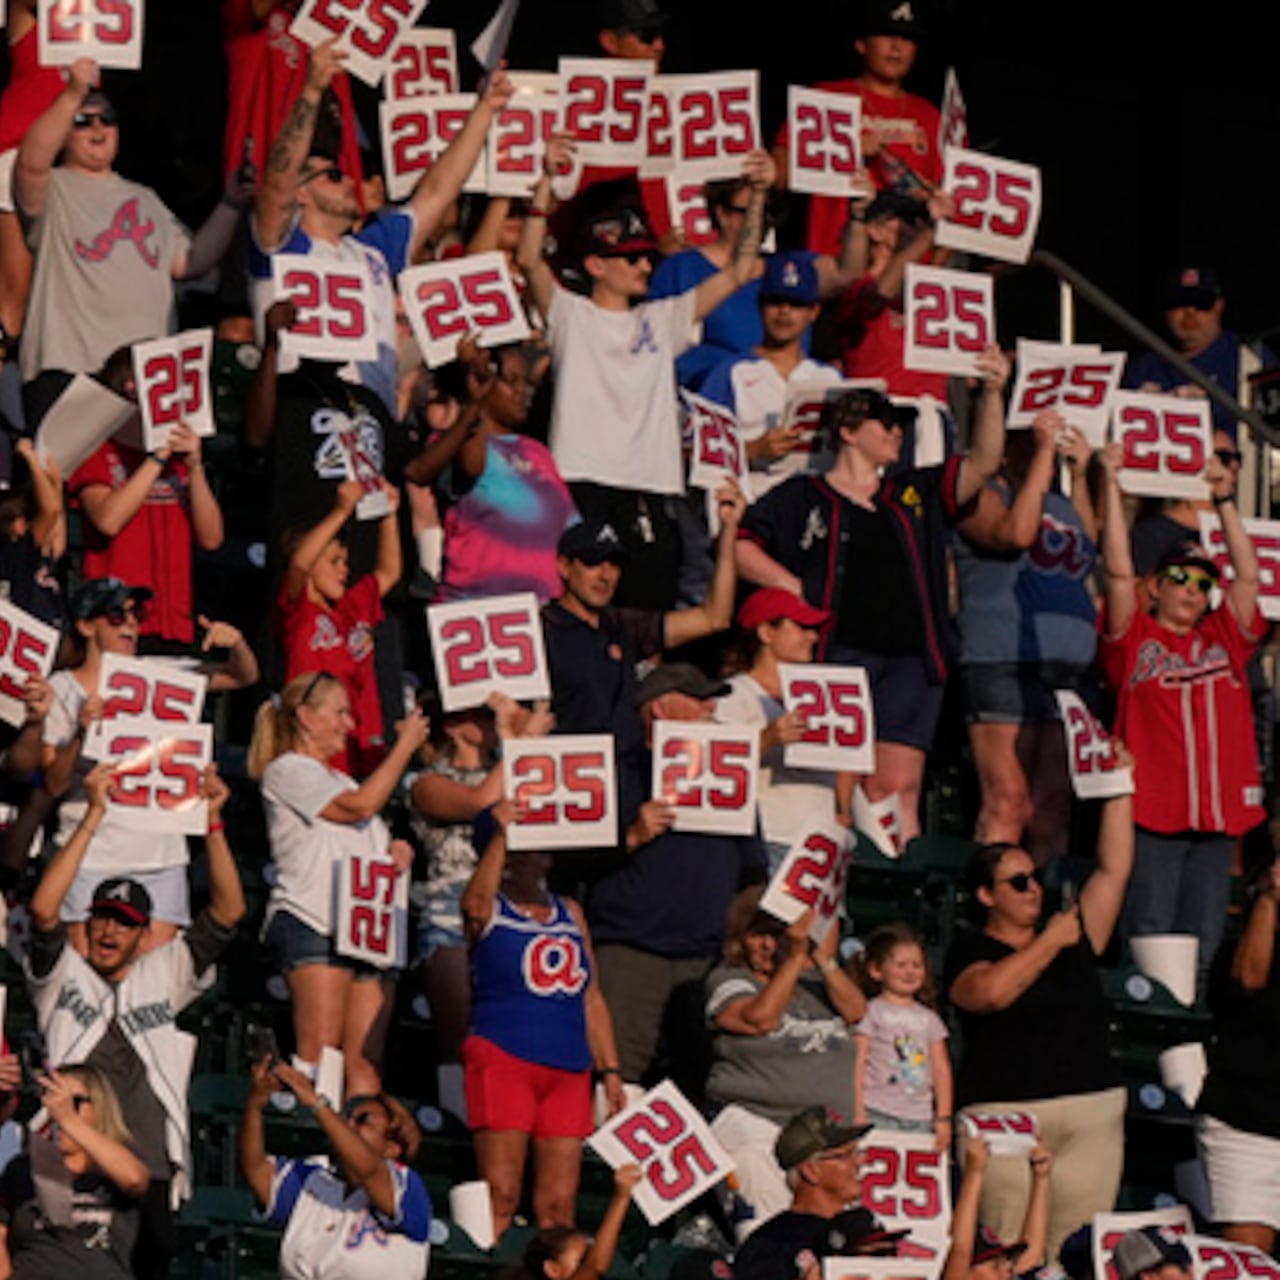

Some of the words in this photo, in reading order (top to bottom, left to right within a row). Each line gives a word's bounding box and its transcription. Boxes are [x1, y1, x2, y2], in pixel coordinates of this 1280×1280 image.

[308, 0, 414, 57] 25
[393, 48, 452, 98] 25
[566, 77, 645, 142] 25
[681, 88, 754, 160] 25
[796, 104, 856, 172] 25
[951, 164, 1032, 238] 25
[284, 272, 366, 338] 25
[417, 271, 513, 338] 25
[912, 284, 986, 351] 25
[144, 348, 202, 426] 25
[1020, 365, 1111, 411] 25
[1122, 406, 1202, 474] 25
[442, 612, 537, 686] 25
[790, 681, 864, 748] 25
[513, 752, 606, 824] 25
[662, 739, 747, 809] 25
[615, 1100, 716, 1200] 25
[860, 1148, 940, 1217] 25
